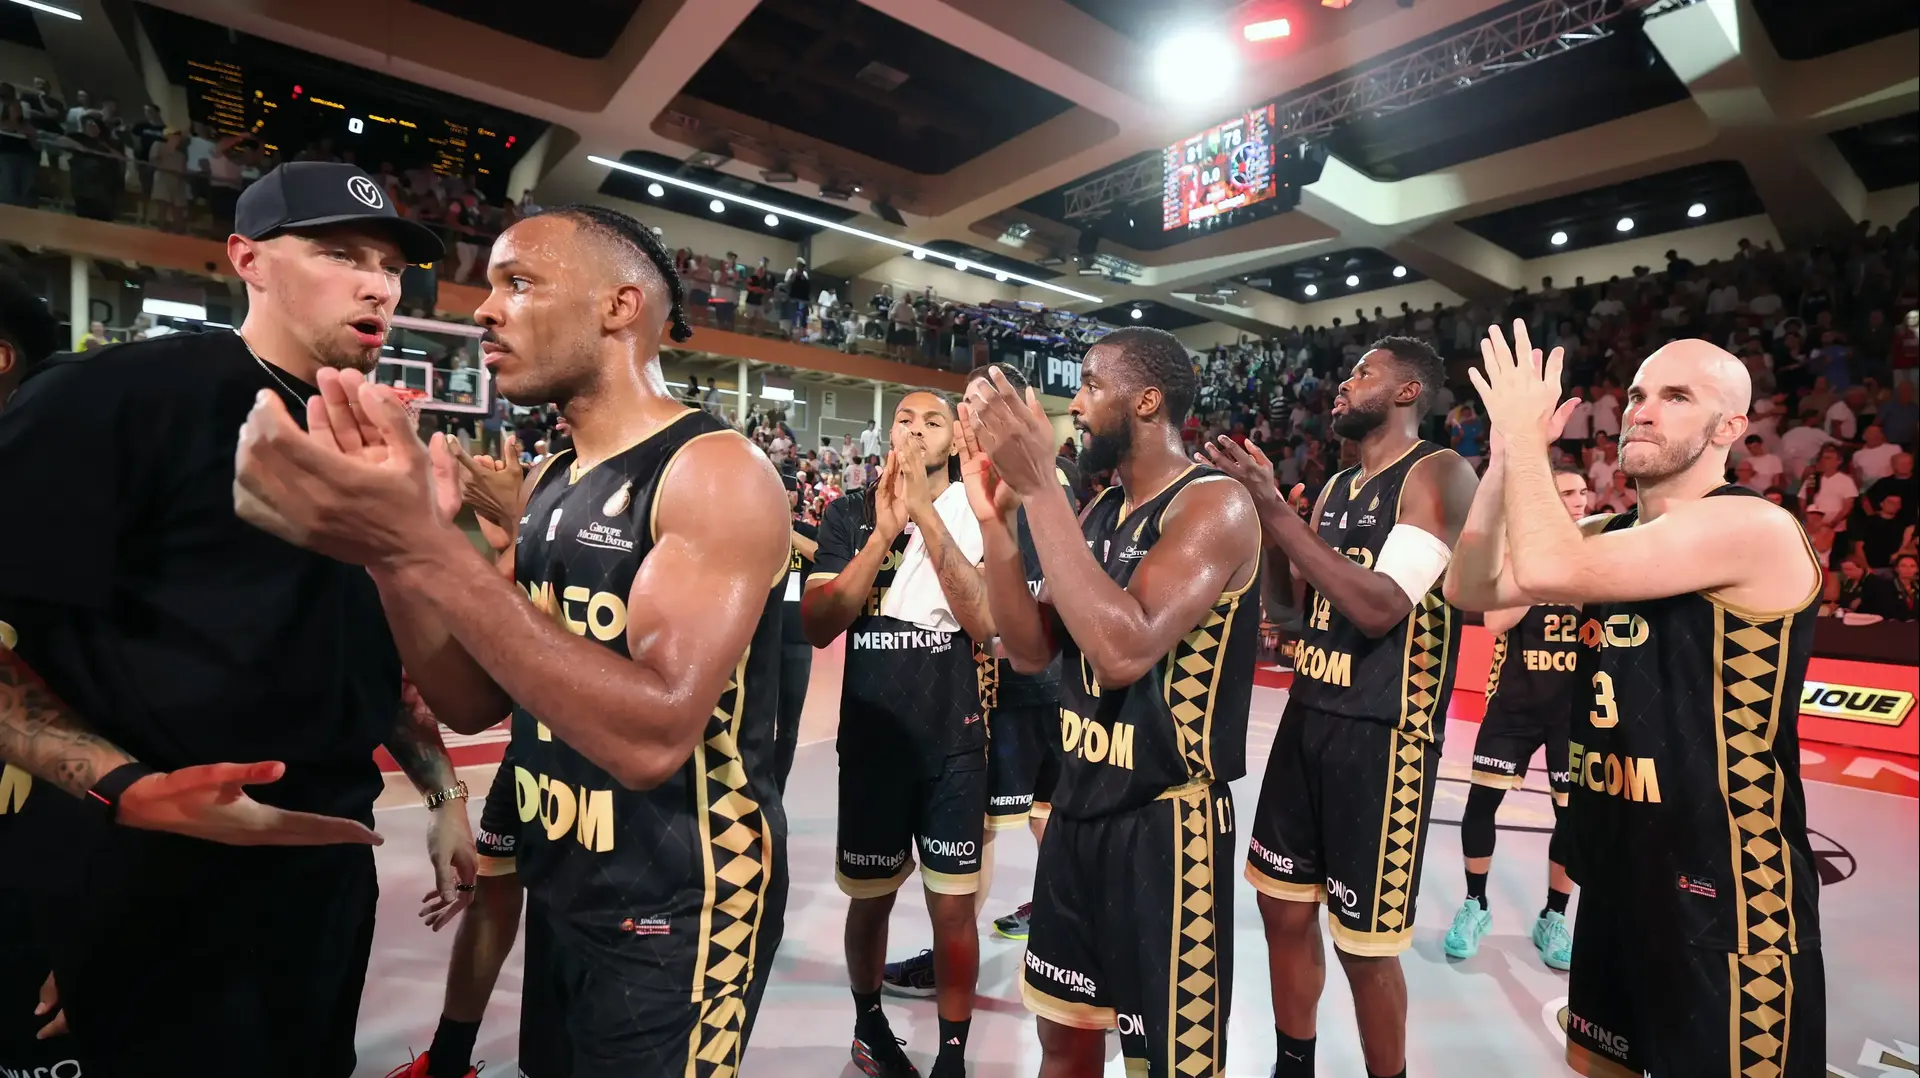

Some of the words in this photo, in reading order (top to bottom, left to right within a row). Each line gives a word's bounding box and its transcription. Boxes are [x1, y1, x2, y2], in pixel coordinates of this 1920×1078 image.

[825, 393, 834, 405] E
[577, 528, 604, 542] MICHEL
[605, 533, 633, 550] PASTOR
[1544, 614, 1577, 642] 22
[1590, 671, 1619, 729] 3
[1803, 687, 1902, 714] JOUE
[1070, 985, 1096, 998] .news
[1598, 1041, 1629, 1060] .news
